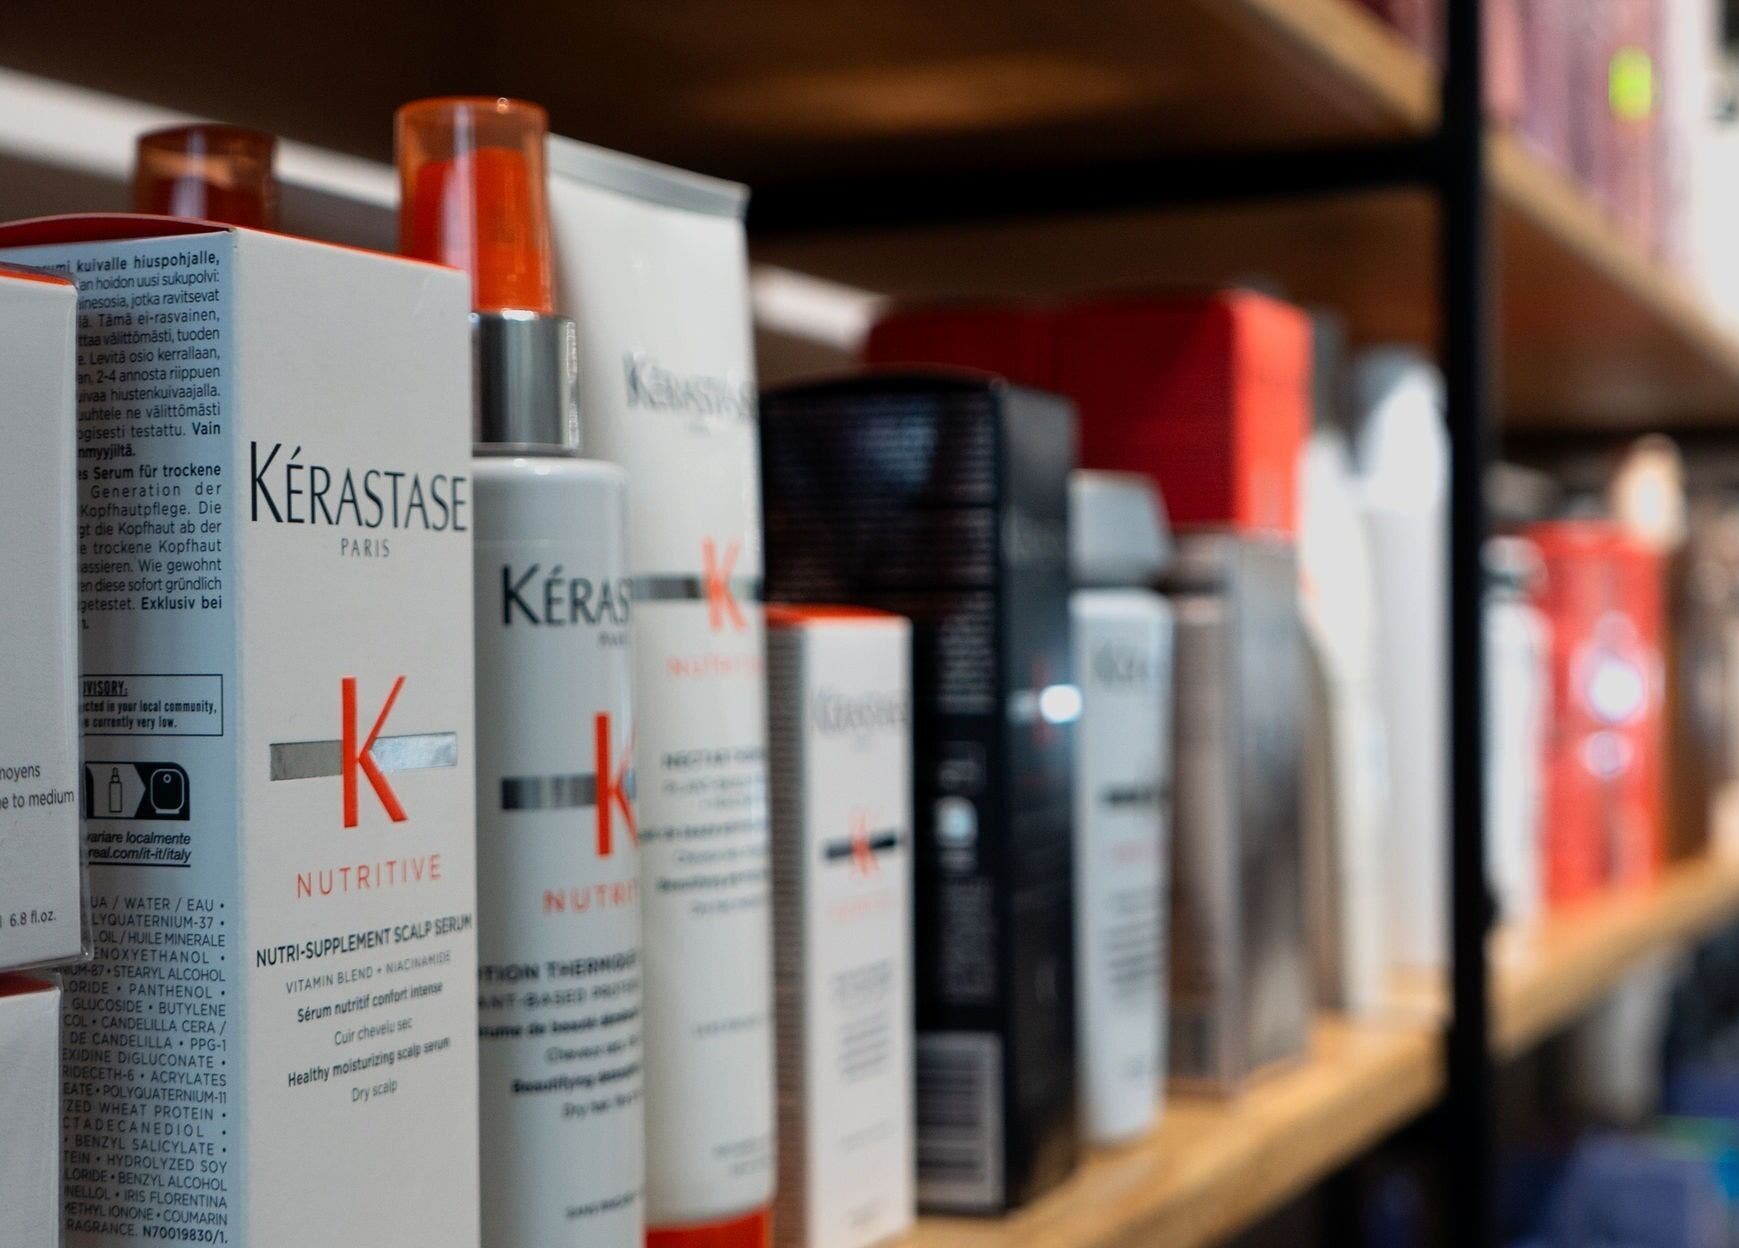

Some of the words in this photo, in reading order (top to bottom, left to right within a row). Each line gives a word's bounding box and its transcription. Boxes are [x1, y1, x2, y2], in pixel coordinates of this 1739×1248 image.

[77, 257, 126, 272] kuivalle
[134, 251, 220, 269] hiuspohjalle,
[96, 278, 135, 289] hoidon
[138, 276, 159, 287] uusi
[162, 272, 220, 286] sukupolvi:
[131, 293, 160, 309] jotka
[163, 289, 219, 302] ravitsevat
[99, 313, 131, 326] Tämä
[138, 309, 220, 325] ei-rasvainen,
[104, 330, 174, 346] välittömästi,
[178, 328, 220, 341] tuoden
[90, 349, 125, 365] Levitä
[130, 349, 153, 362] osio
[158, 347, 220, 361] kerrallaan,
[97, 370, 116, 383] 2-4
[119, 368, 166, 382] annosta
[169, 365, 220, 380] riippuen
[111, 385, 220, 401] hiustenkuivaajalla.
[126, 409, 141, 418] ne
[146, 403, 220, 418] välittömästi
[131, 424, 186, 438] testattu.
[192, 423, 220, 435] Vain
[94, 465, 133, 480] Serum
[140, 464, 157, 478] für
[163, 464, 221, 477] trockene
[91, 484, 181, 498] Generation
[195, 482, 221, 495] der
[251, 441, 467, 532] KÉRASTASE
[80, 501, 190, 517] Kopfhautpflege.
[199, 501, 221, 515] Die
[95, 523, 113, 536] die
[119, 521, 174, 537] Kopfhaut
[180, 521, 195, 533] ab
[201, 521, 221, 533] der
[94, 541, 151, 554] trockene
[159, 539, 221, 554] Kopfhaut
[341, 538, 390, 557] PARIS
[139, 559, 162, 573] Wie
[167, 559, 221, 574] gewohnt
[95, 578, 125, 592] diese
[129, 577, 163, 591] sofort
[166, 577, 221, 593] gründlich
[700, 534, 748, 633] K
[142, 596, 195, 610] Exklusiv
[202, 596, 222, 609] bei
[118, 702, 136, 714] your
[140, 700, 161, 712] local
[164, 700, 216, 715] community,
[93, 716, 133, 730] currently
[138, 718, 155, 730] very
[159, 716, 177, 728] low.
[341, 675, 409, 828] K
[12, 793, 25, 808] to
[29, 789, 74, 806] medium
[126, 831, 191, 844] localmente
[296, 854, 443, 898] NUTRITIVE
[124, 896, 170, 910] WATER
[187, 898, 213, 912] EAU
[10, 912, 27, 927] 6.8
[92, 914, 213, 929] LYQUATERNIUM-37
[128, 931, 162, 945] HUILE
[165, 933, 225, 947] MINERALE
[256, 928, 390, 967] NUTRI-SUPPLEMENT
[395, 920, 431, 943] SCALP
[435, 913, 472, 936] SERUM
[114, 966, 164, 980] STEARYL
[168, 968, 225, 981] ALCOHOL
[286, 974, 333, 994] VITAMIN
[338, 966, 373, 984] BLEND
[386, 950, 451, 975] NIACINAMIDE
[64, 981, 108, 994] ORIDE
[130, 983, 212, 998] PANTHENOL
[73, 998, 142, 1013] GLUCOSIDE
[159, 1002, 226, 1017] BUTYLENE
[297, 1005, 332, 1023] Sérum
[335, 994, 370, 1014] nutritif
[373, 989, 408, 1006] confort
[411, 982, 443, 998] intense
[102, 1017, 177, 1032] CANDELILLA
[182, 1020, 215, 1033] CERA
[335, 1029, 354, 1046] Cuir
[358, 1021, 395, 1040] chevelu
[70, 1032, 85, 1044] DE
[92, 1033, 172, 1049] CANDELILLA
[191, 1038, 226, 1051] PPG-1
[118, 1051, 213, 1068] DIGLUCONATE
[288, 1066, 331, 1088] Healthy
[333, 1051, 395, 1076] moisturizing
[397, 1043, 421, 1060] scalp
[424, 1036, 450, 1052] serum
[151, 1071, 226, 1086] ACRYLATES
[104, 1085, 227, 1104] POLYQUATERNIUM-11
[352, 1086, 370, 1102] Dry
[373, 1077, 398, 1097] scalp
[100, 1102, 147, 1117] WHEAT
[155, 1105, 213, 1120] PROTEIN
[75, 1135, 125, 1150] BENZYL
[133, 1138, 214, 1155] SALICYLATE
[108, 1154, 194, 1171] HYDROLYZED
[201, 1160, 227, 1174] SOY
[119, 1172, 164, 1187] BENZYL
[168, 1175, 227, 1191] ALCOHOL
[125, 1190, 145, 1203] IRIS
[151, 1191, 227, 1208] FLORENTINA
[109, 1206, 155, 1220] IONONE
[164, 1209, 227, 1225] COUMARIN
[143, 1225, 228, 1244] N70019830/1.
